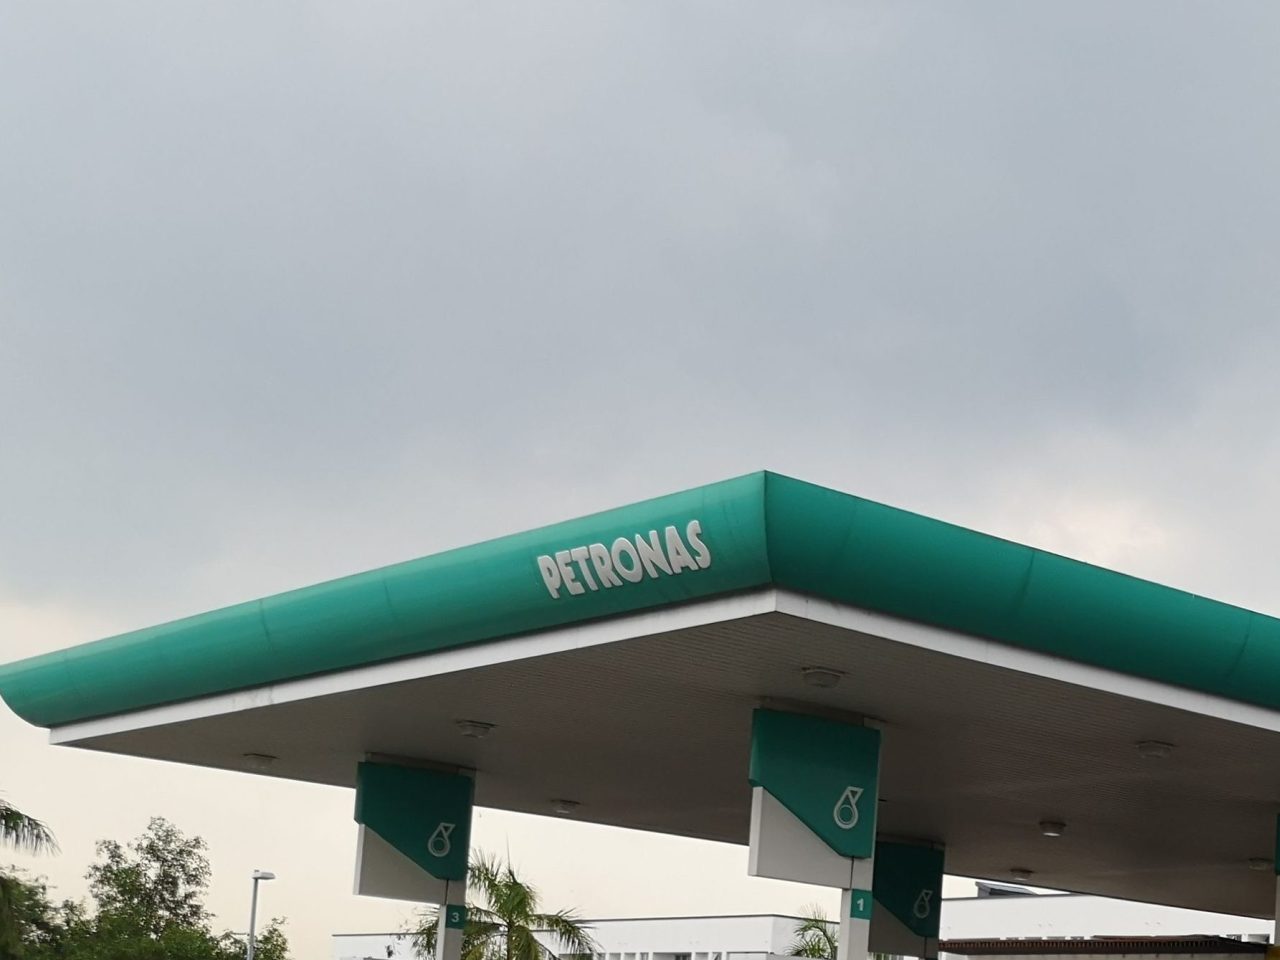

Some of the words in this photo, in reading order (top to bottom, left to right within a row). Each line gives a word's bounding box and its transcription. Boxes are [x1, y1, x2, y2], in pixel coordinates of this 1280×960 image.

[537, 519, 712, 600] PETRONAS
[857, 898, 865, 911] 1
[451, 912, 460, 923] 3
